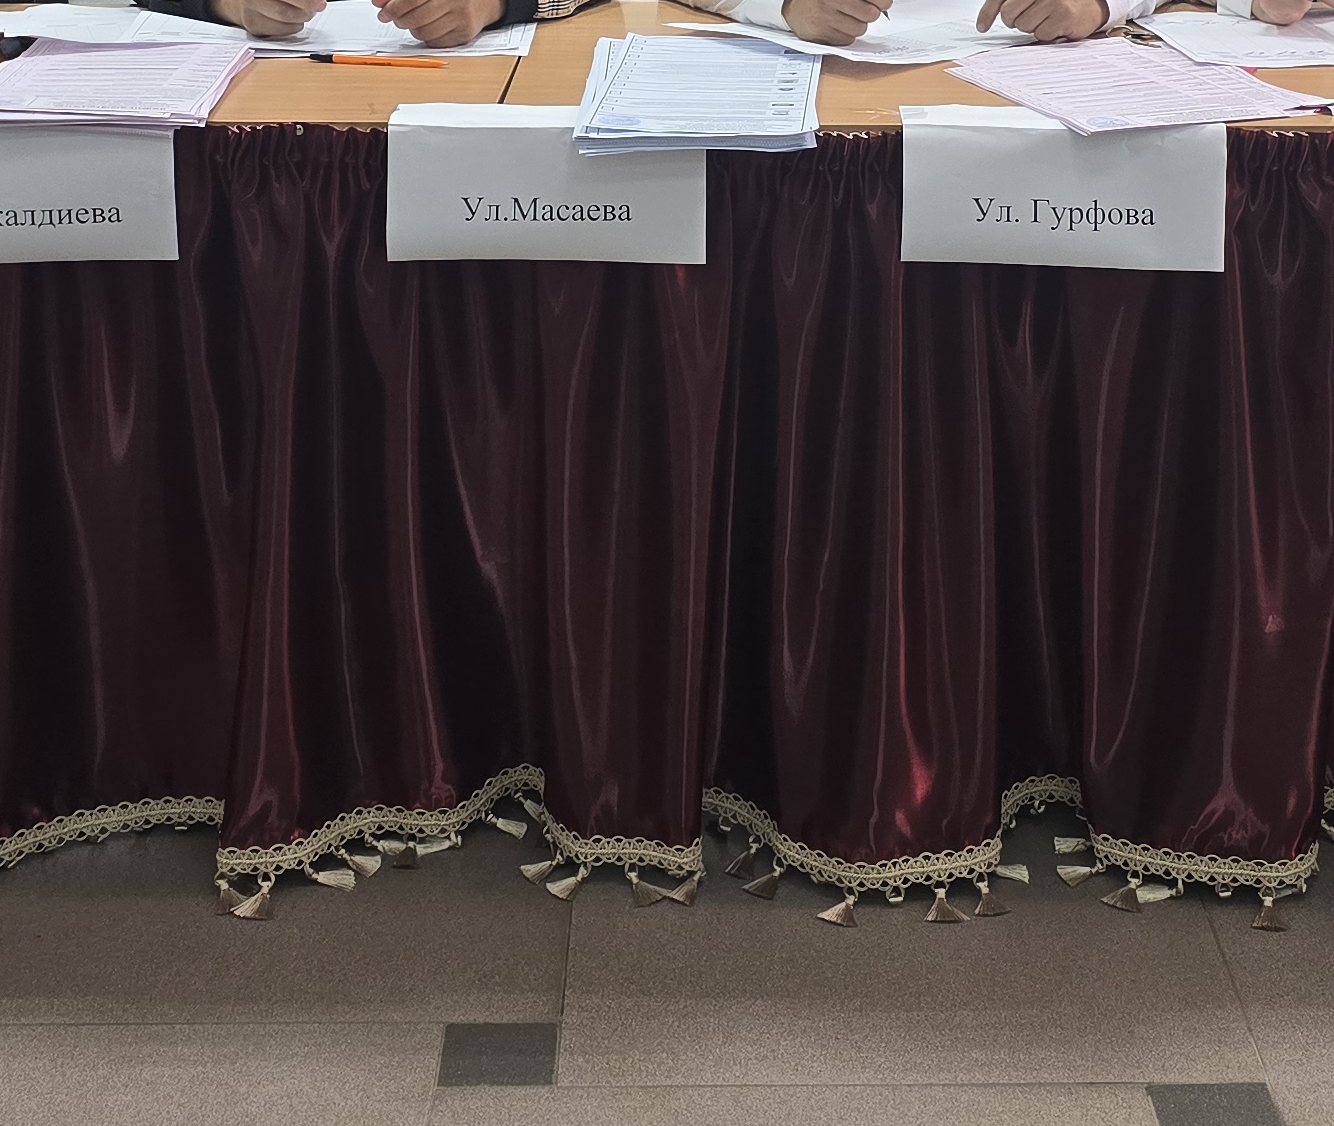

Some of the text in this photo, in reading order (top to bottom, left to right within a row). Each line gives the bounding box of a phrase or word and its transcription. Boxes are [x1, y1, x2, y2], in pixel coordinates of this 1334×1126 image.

[461, 197, 633, 223] Ул.Масаева
[971, 197, 1157, 233] Ул. Гурфова
